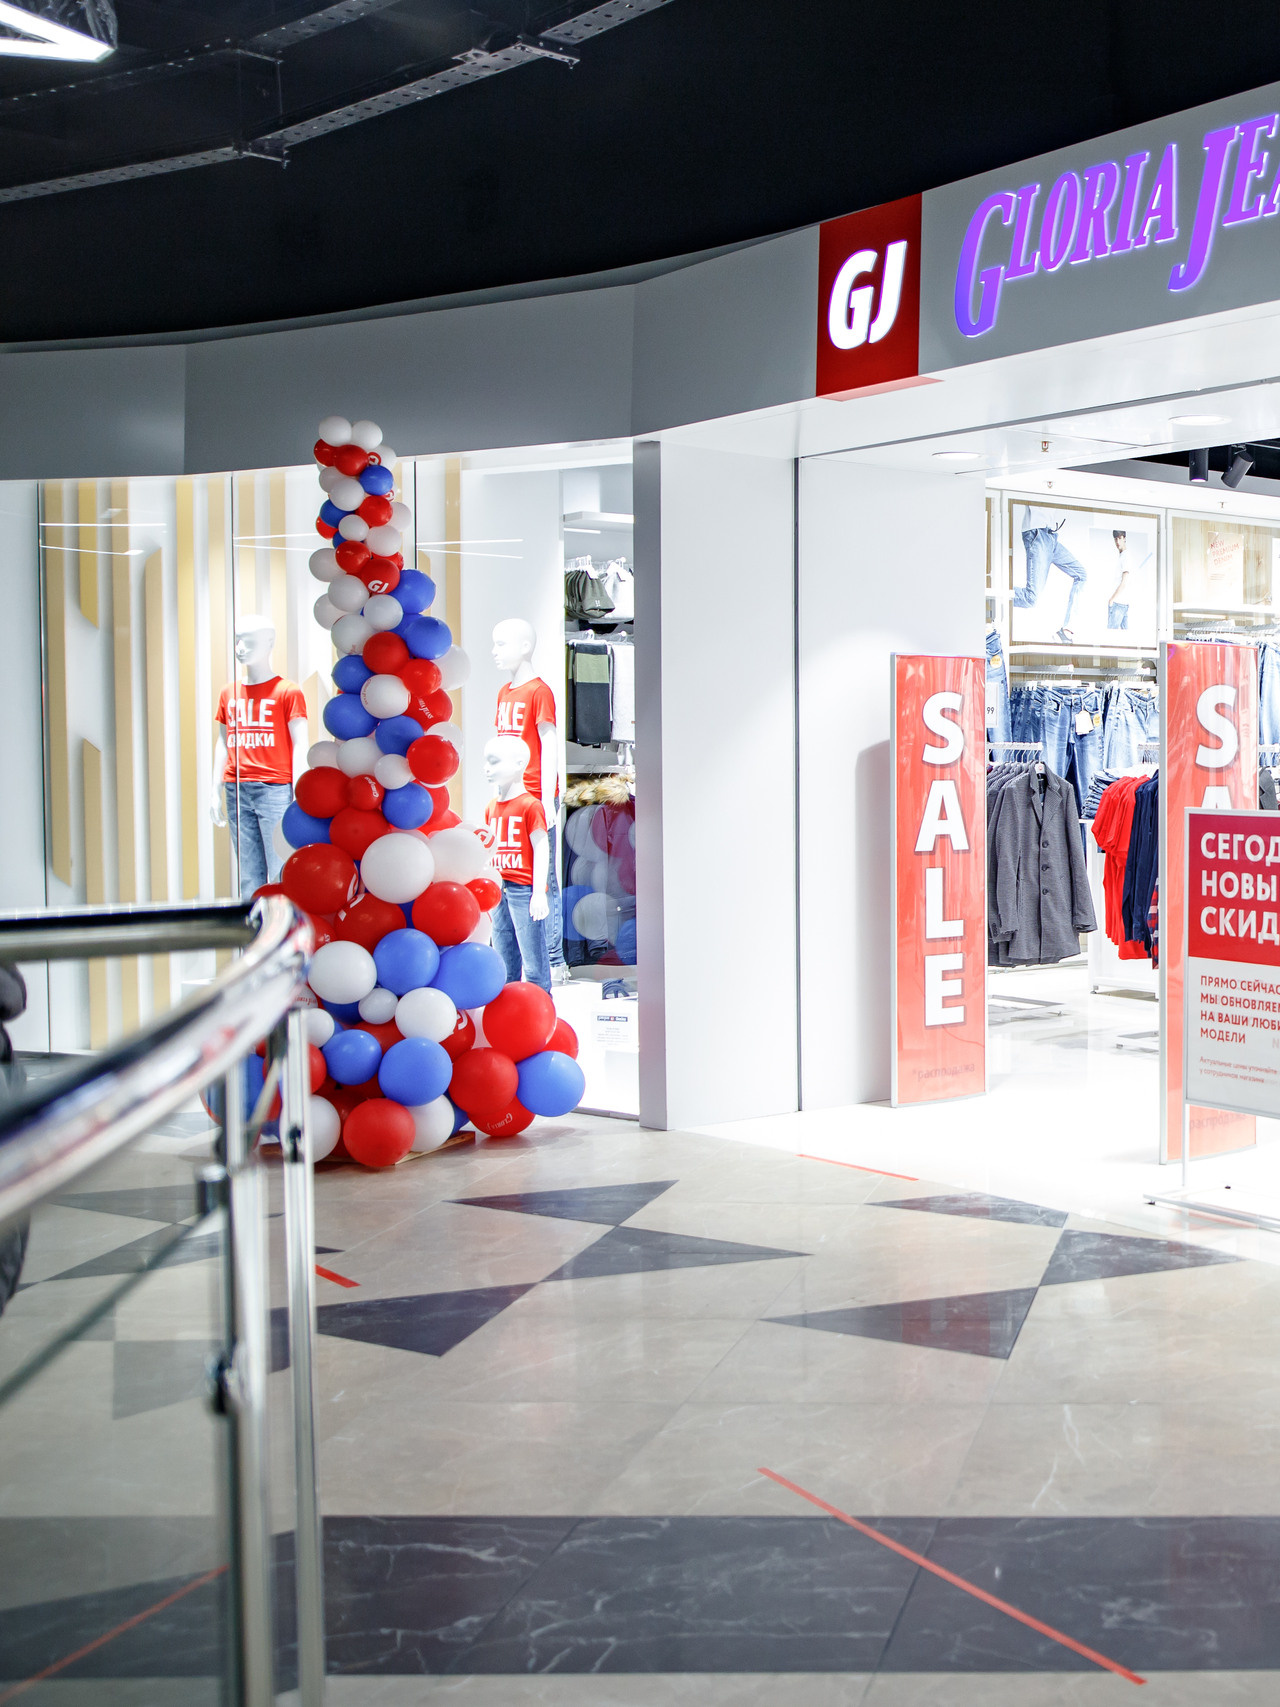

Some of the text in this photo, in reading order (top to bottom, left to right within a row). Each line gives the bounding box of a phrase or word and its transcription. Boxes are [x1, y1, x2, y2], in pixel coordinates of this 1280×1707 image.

[954, 141, 1178, 339] GLORIA
[828, 239, 908, 351] GJ
[367, 579, 389, 593] GJ
[227, 698, 276, 728] SALE
[498, 701, 526, 731] ALE
[490, 815, 523, 848] LE
[914, 690, 971, 1028] SALE
[1200, 975, 1237, 990] ПРЯМО
[1200, 993, 1217, 1005] МЫ
[1200, 1010, 1215, 1022] НА
[1217, 1012, 1249, 1027] ВАШИ
[1200, 1027, 1246, 1044] МОДЕЛИ
